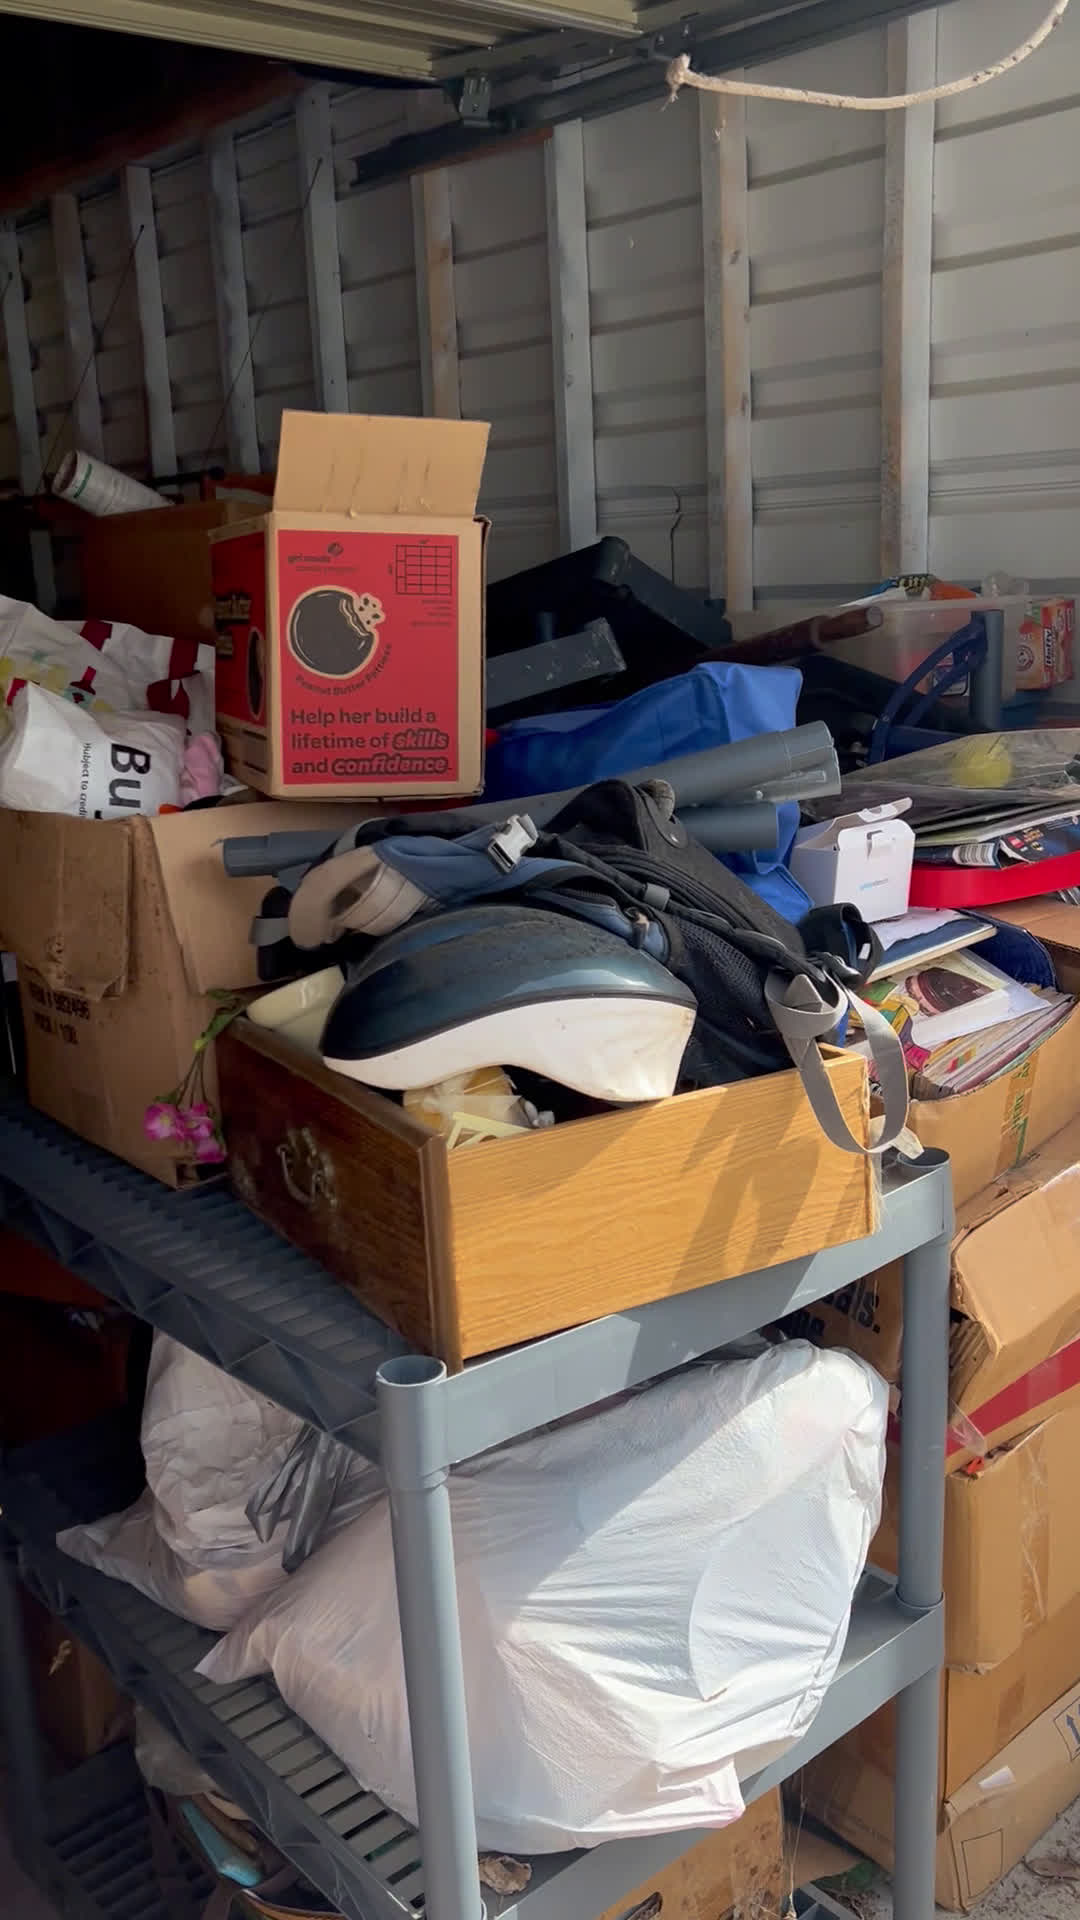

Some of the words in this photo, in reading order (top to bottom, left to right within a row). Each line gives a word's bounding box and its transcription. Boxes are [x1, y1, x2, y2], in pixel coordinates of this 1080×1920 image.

[290, 708, 335, 727] Help
[339, 708, 371, 724] her
[375, 707, 422, 724] build
[426, 711, 437, 724] a
[291, 733, 366, 749] lifetime
[370, 733, 389, 749] of
[393, 728, 449, 750] skills
[291, 757, 328, 774] and
[80, 781, 89, 791] to
[109, 743, 152, 815] Bu
[78, 792, 88, 817] credi
